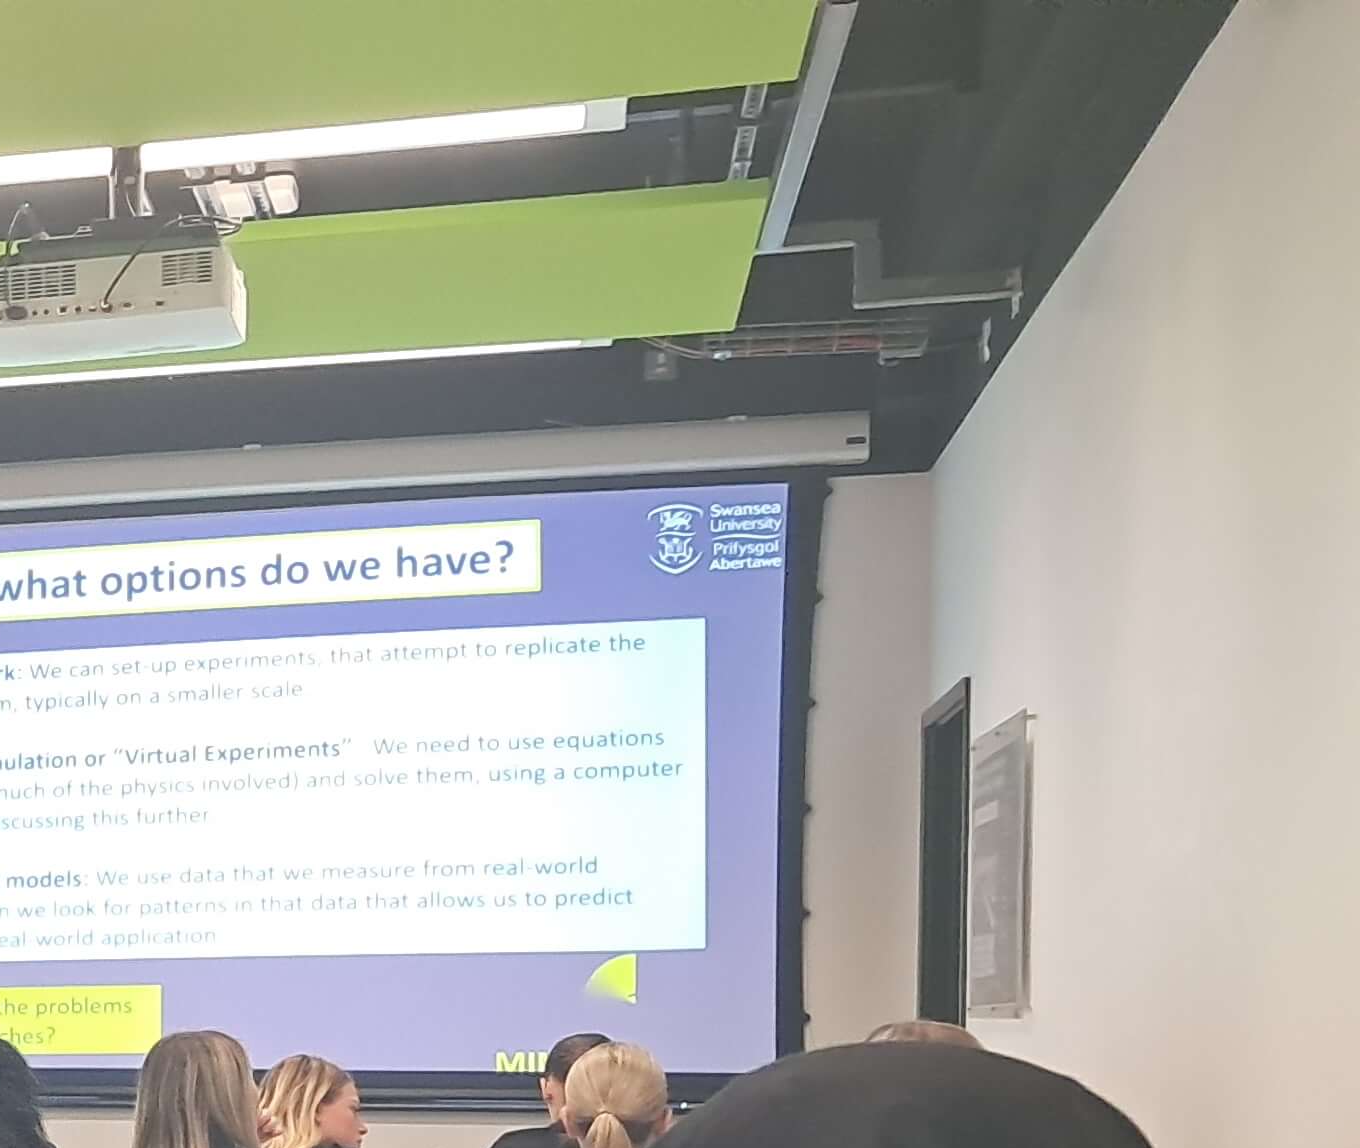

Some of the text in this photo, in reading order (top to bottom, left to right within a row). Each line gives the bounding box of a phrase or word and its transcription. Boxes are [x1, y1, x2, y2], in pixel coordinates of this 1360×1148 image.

[710, 503, 781, 518] Swansea
[710, 517, 782, 532] University
[100, 559, 246, 602] options
[260, 552, 309, 586] do
[322, 556, 381, 582] we
[395, 539, 514, 578] have?
[709, 556, 782, 570] Abertawe
[28, 662, 63, 680] We
[68, 662, 104, 678] can
[329, 646, 372, 664] that
[379, 641, 467, 663] attempt
[474, 641, 497, 657] to
[504, 634, 602, 660] replicate
[607, 631, 647, 653] the
[23, 688, 109, 713] typically
[115, 690, 142, 706] on
[148, 690, 160, 704] a
[166, 681, 243, 704] smaller
[83, 752, 107, 768] or
[372, 736, 408, 756] We
[415, 733, 470, 753] need
[476, 734, 500, 752] to
[506, 735, 546, 751] use
[551, 727, 665, 753] equations
[51, 778, 73, 798] of
[78, 778, 113, 797] the
[120, 776, 195, 800] physics
[201, 770, 299, 792] involved)
[305, 769, 346, 788] and
[352, 767, 408, 787] solve
[415, 766, 480, 785] them,
[487, 766, 547, 786] using
[552, 766, 566, 781] a
[571, 759, 684, 783] computer
[91, 808, 129, 826] this
[95, 869, 129, 886] We
[136, 871, 172, 885] use
[178, 866, 225, 884] data
[231, 863, 275, 882] that
[282, 866, 313, 881] we
[321, 864, 415, 880] measure
[422, 858, 476, 878] from
[15, 904, 46, 919] we
[52, 898, 95, 917] look
[102, 898, 131, 916] for
[138, 898, 227, 918] patterns
[233, 899, 253, 912] in
[259, 894, 302, 912] that
[310, 892, 357, 911] data
[364, 891, 409, 909] that
[415, 889, 486, 909] allows
[492, 893, 518, 908] us
[523, 890, 548, 907] to
[553, 886, 634, 911] predict
[100, 927, 216, 948] application
[36, 997, 133, 1018] problems
